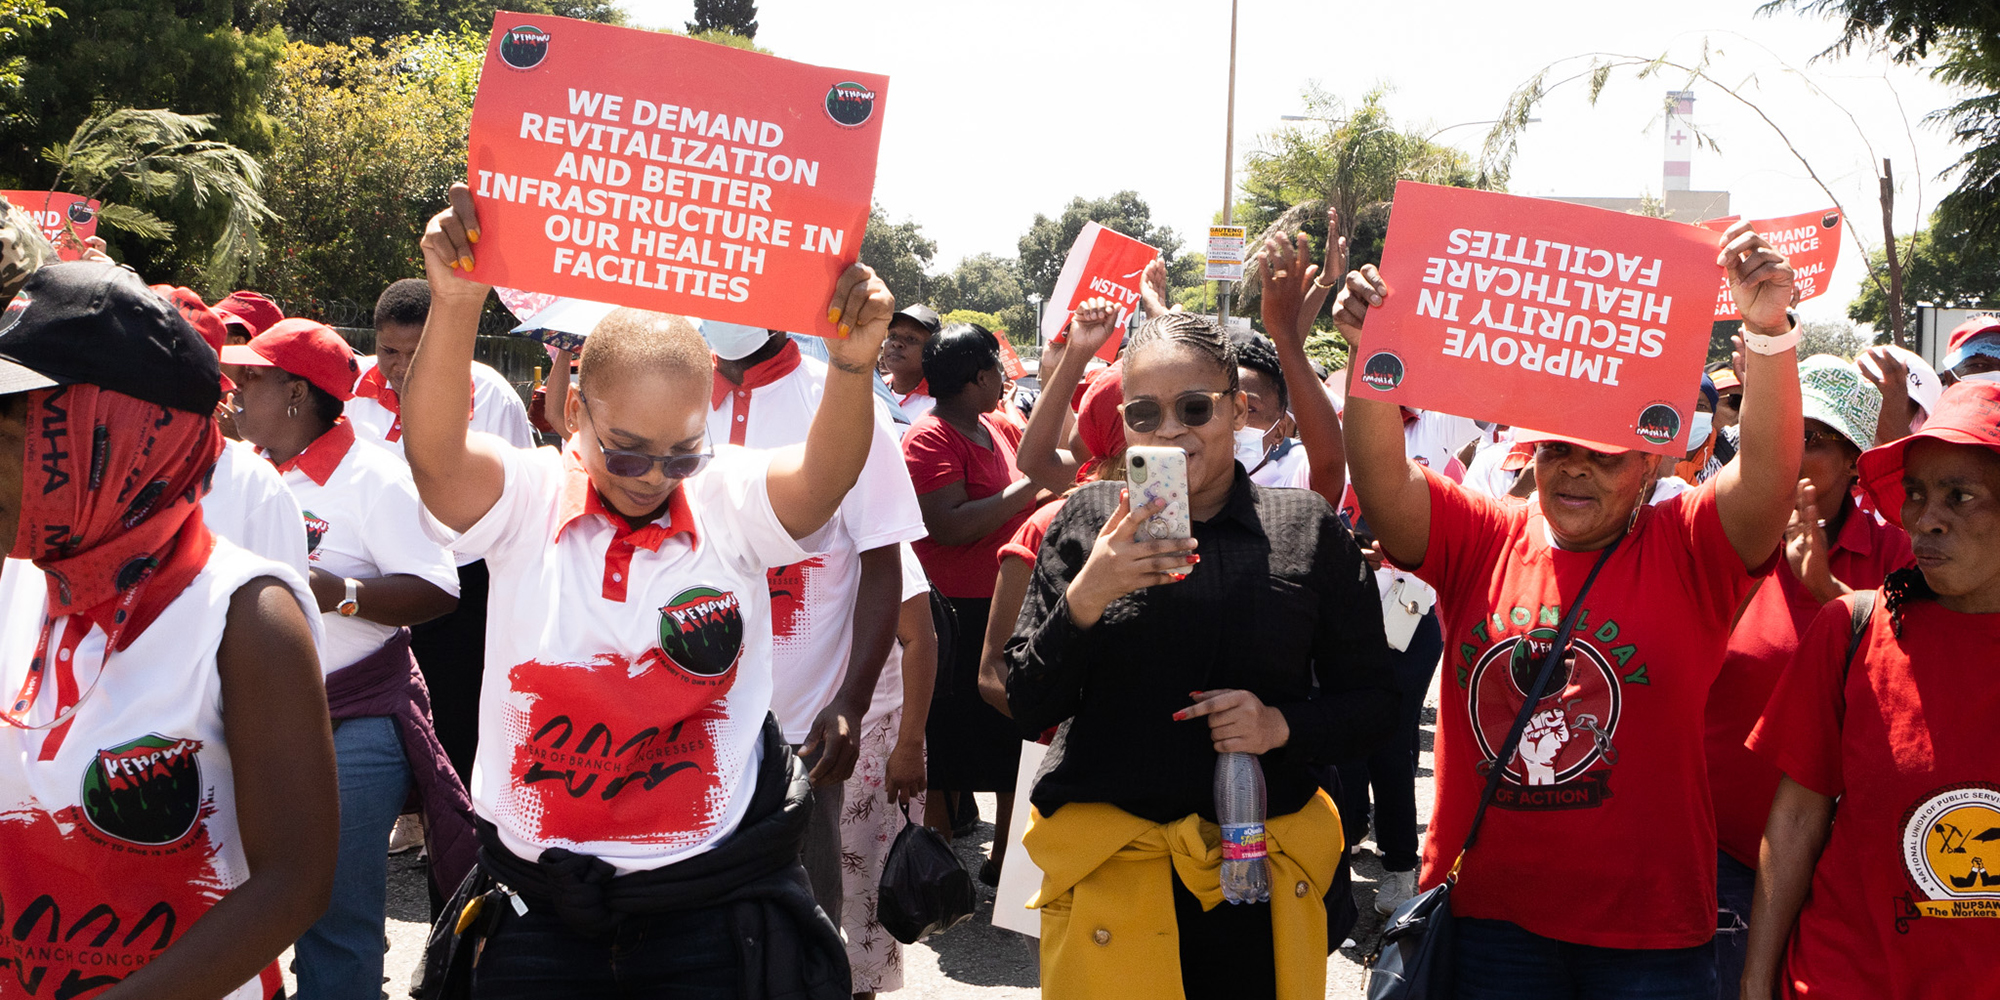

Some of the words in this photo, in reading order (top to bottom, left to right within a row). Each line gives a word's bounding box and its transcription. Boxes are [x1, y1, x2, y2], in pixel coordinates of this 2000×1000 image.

[568, 88, 622, 121] WE
[632, 100, 784, 148] DEMAND
[520, 113, 818, 186] REVITALIZATION
[554, 152, 631, 187] AND
[642, 166, 772, 212] BETTER
[478, 170, 792, 247] INFRASTRUCTURE
[800, 225, 844, 256] IN
[544, 216, 620, 250] OUR
[630, 228, 766, 275] HEALTH
[1446, 228, 1662, 287] FACILITIES
[554, 248, 750, 303] FACILITIES
[1423, 257, 1672, 323] HEALTHCARE
[1416, 289, 1460, 320] IN
[1470, 298, 1666, 358] SECURITY
[1442, 327, 1623, 386] IMPROVE
[672, 594, 737, 624] NEHAWU
[1456, 603, 1590, 689] NATIONL
[1594, 619, 1651, 686] DAY
[550, 751, 565, 763] OF
[569, 756, 621, 772] BRANCH
[626, 740, 705, 772] CNGRESSES
[1496, 788, 1514, 802] OF
[1519, 789, 1589, 805] ACTION
[1927, 805, 1936, 816] OF
[1937, 792, 1970, 808] PUBLIC
[1912, 814, 1928, 838] UNION
[1910, 840, 1929, 884] NATIONAL
[1927, 907, 1948, 917] The
[1952, 908, 1997, 918] Workers
